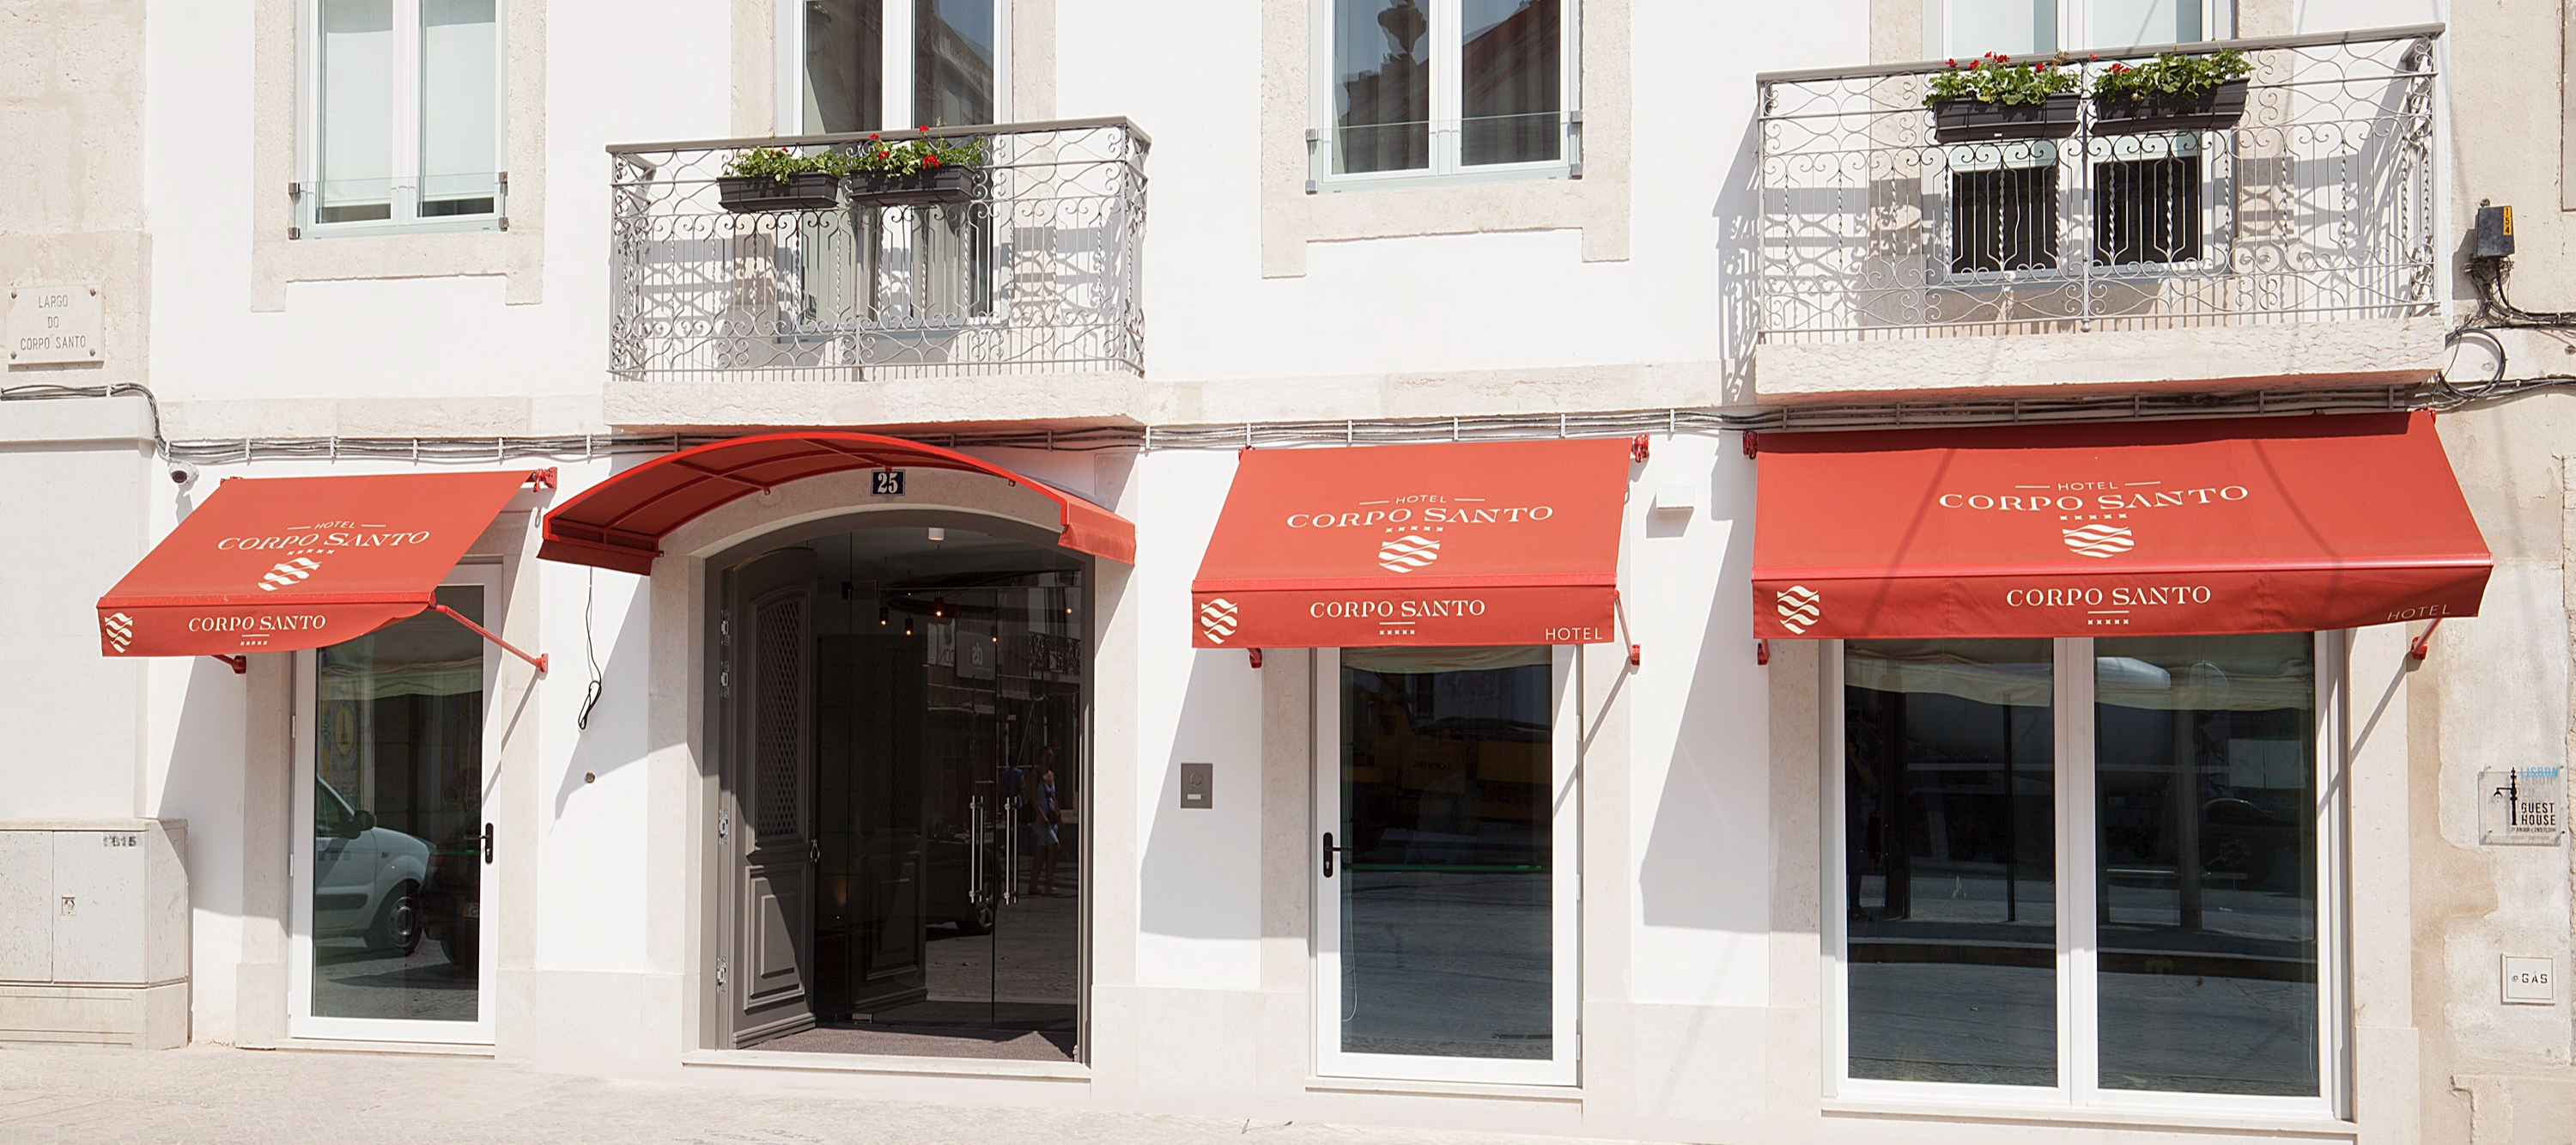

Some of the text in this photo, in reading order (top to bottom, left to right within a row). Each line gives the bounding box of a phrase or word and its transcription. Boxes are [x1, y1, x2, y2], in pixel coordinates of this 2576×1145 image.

[39, 295, 69, 308] LARGO
[47, 316, 59, 328] DO
[21, 335, 86, 350] CORPO SANTO
[878, 472, 898, 494] 25
[2057, 481, 2118, 490] HOTEL
[1395, 494, 1447, 504] HOTEL
[1939, 485, 2248, 511] CORPO SANTO
[1286, 506, 1553, 528] CORPO SANTO
[314, 521, 355, 529] HOTEL
[217, 531, 430, 551] CORPO SANTO
[2006, 586, 2211, 606] CORPO SANTO
[1309, 600, 1485, 618] CORPO SANTO
[2387, 604, 2451, 621] HOTEL
[188, 615, 326, 632] CORPO SANTO
[1546, 627, 1603, 641] HOTEL
[2520, 766, 2559, 778] LISBON
[2521, 802, 2555, 813] GUEST
[2521, 814, 2556, 825] HOUSE
